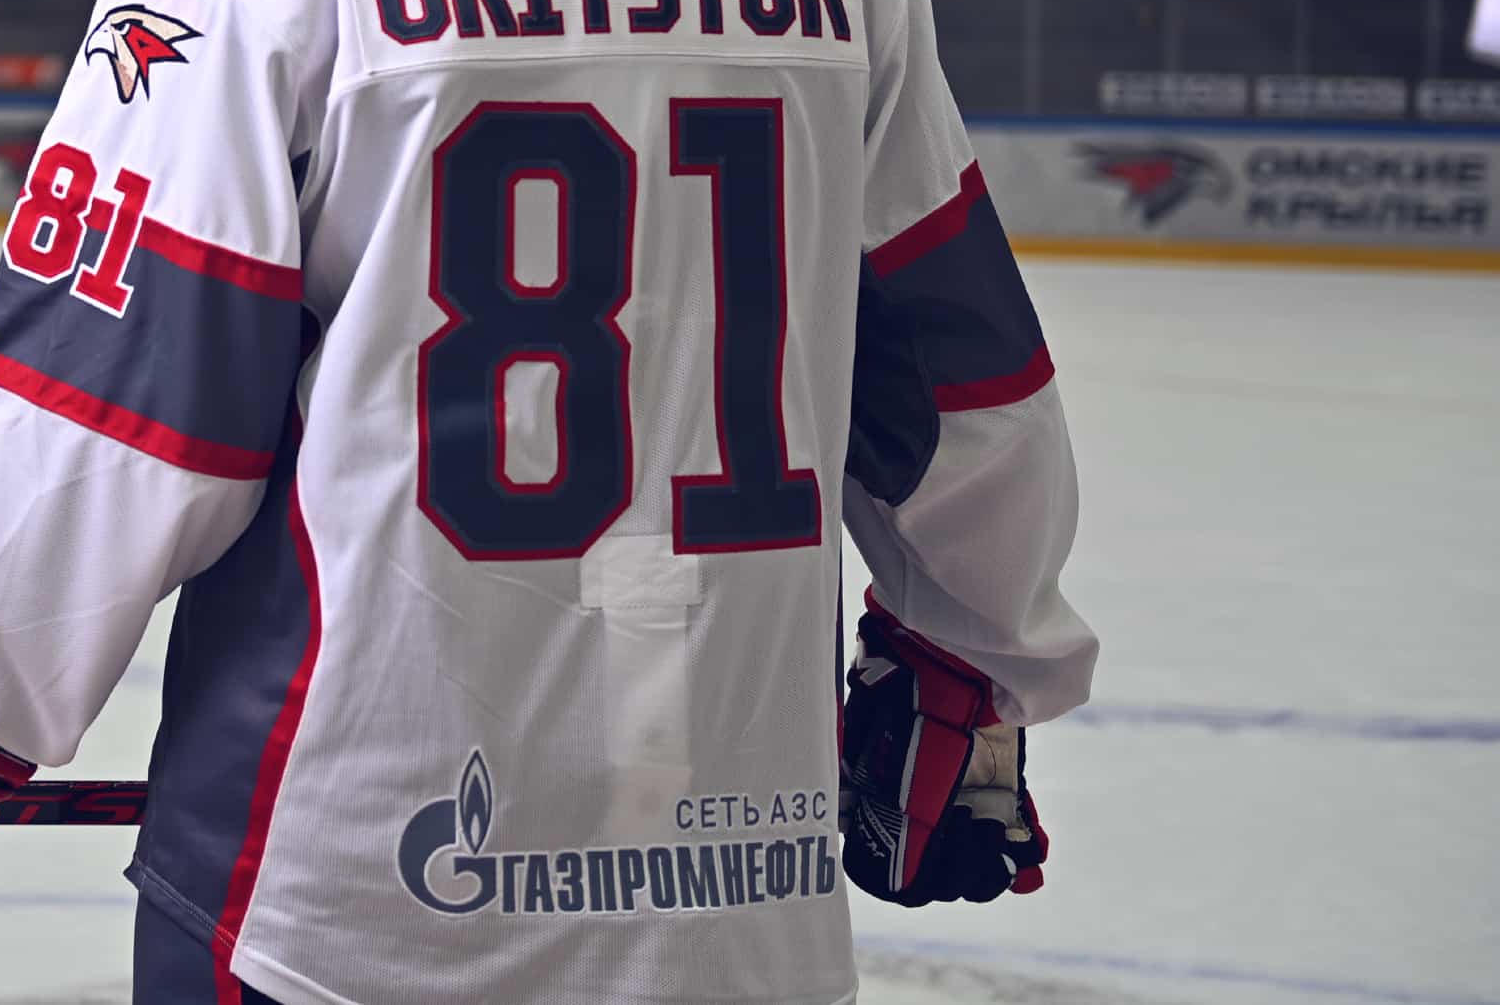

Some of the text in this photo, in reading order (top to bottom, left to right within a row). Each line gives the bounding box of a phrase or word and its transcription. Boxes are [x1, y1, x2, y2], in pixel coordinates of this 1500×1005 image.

[2, 142, 151, 319] 81
[417, 98, 822, 562] 81
[675, 791, 828, 829] СЕТЬ АЗС
[502, 836, 836, 914] ГАЗПРОМНЕФТЬ
